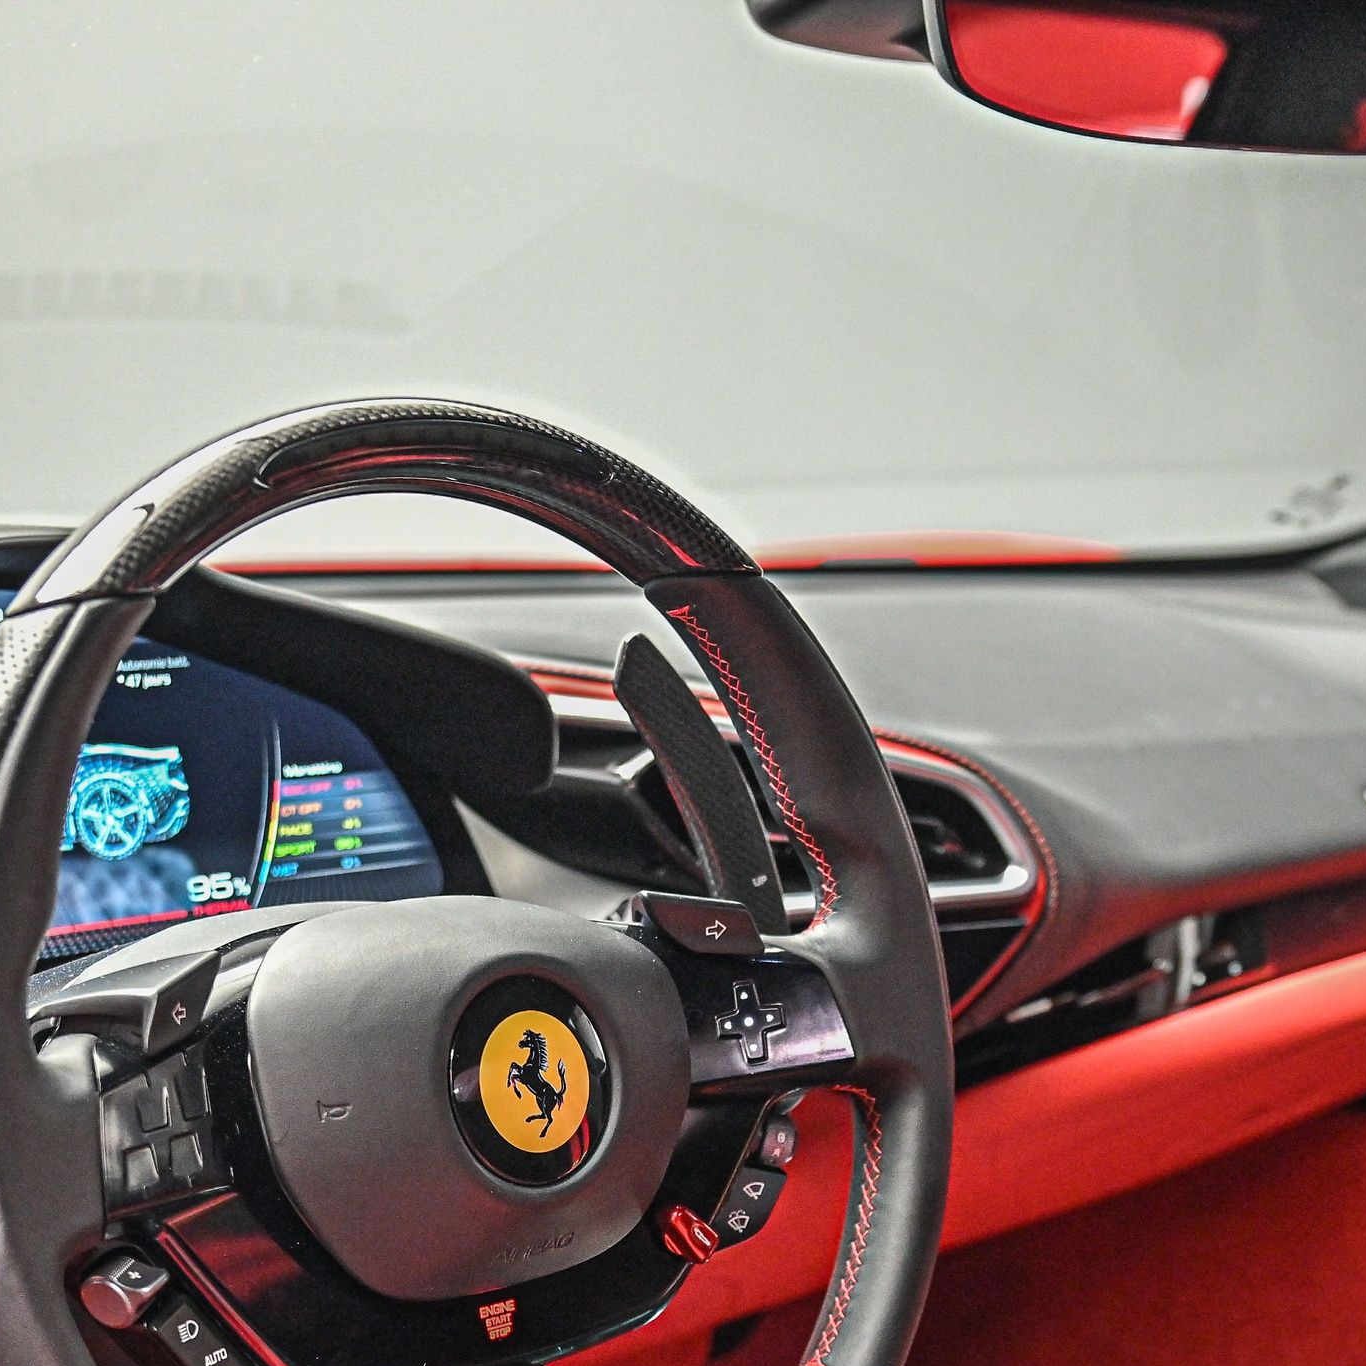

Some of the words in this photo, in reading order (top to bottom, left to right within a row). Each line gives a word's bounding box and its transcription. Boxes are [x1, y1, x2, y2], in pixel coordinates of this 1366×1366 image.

[186, 871, 252, 903] 95%
[479, 1299, 516, 1319] ENGINE
[485, 1313, 512, 1329] START
[488, 1326, 512, 1341] STOP
